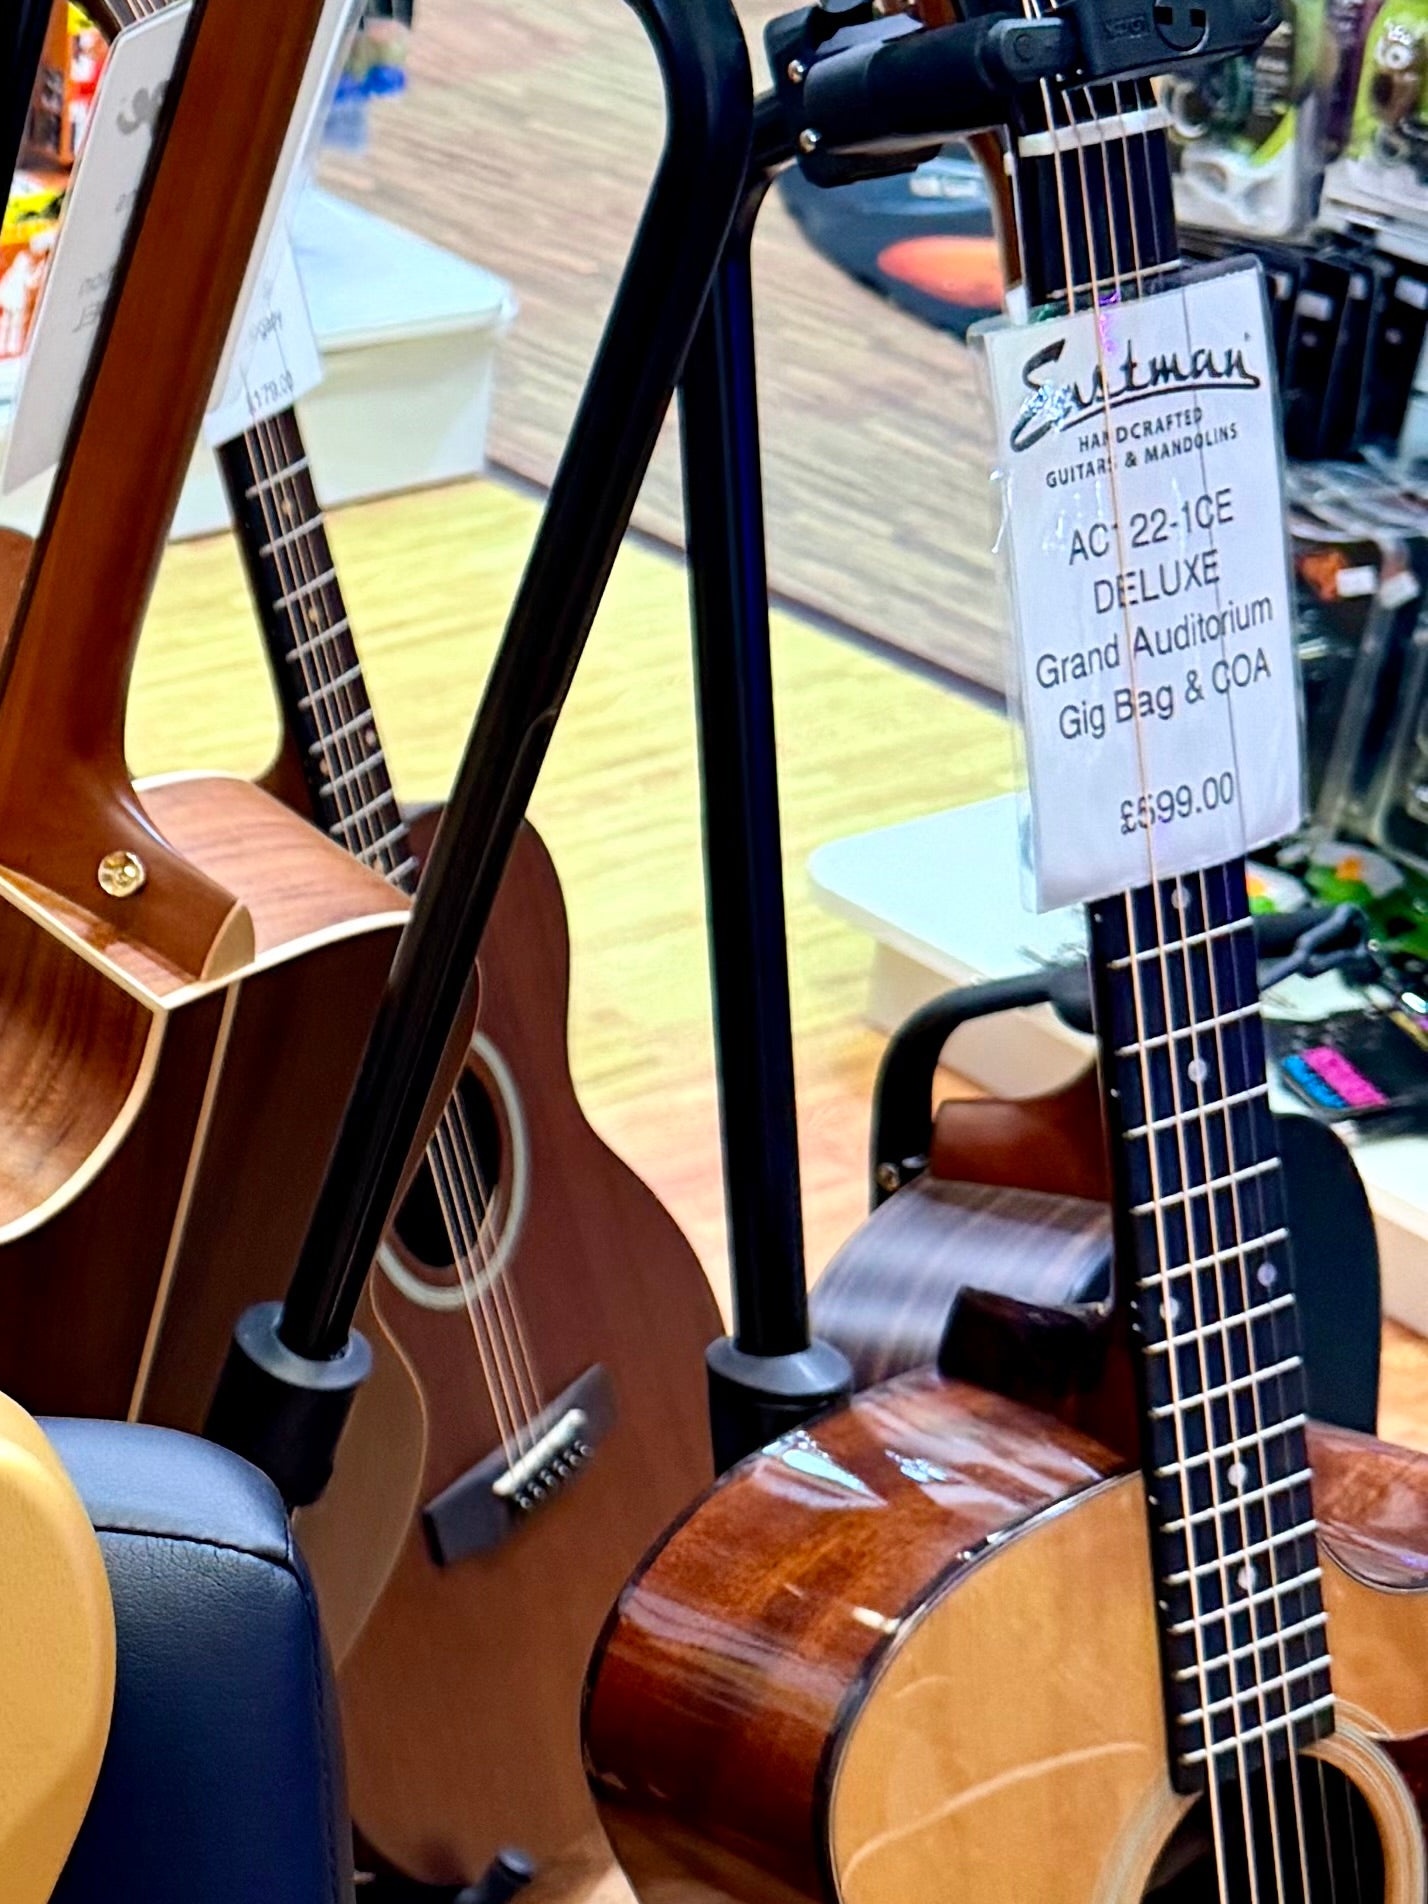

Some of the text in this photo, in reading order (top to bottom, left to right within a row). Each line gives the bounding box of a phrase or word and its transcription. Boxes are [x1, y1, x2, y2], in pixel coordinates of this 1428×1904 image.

[1010, 337, 1261, 453] Eastman
[1078, 407, 1203, 453] HANDCRAFTED
[1045, 422, 1239, 490] GUITARS & MANDOLINS
[1069, 488, 1234, 566] AC22-1CE
[1094, 549, 1221, 615] DELUXE
[1036, 595, 1273, 690] Grand Auditorium
[1058, 647, 1272, 740] Gig Bag & COA
[1120, 771, 1235, 836] £599.00
